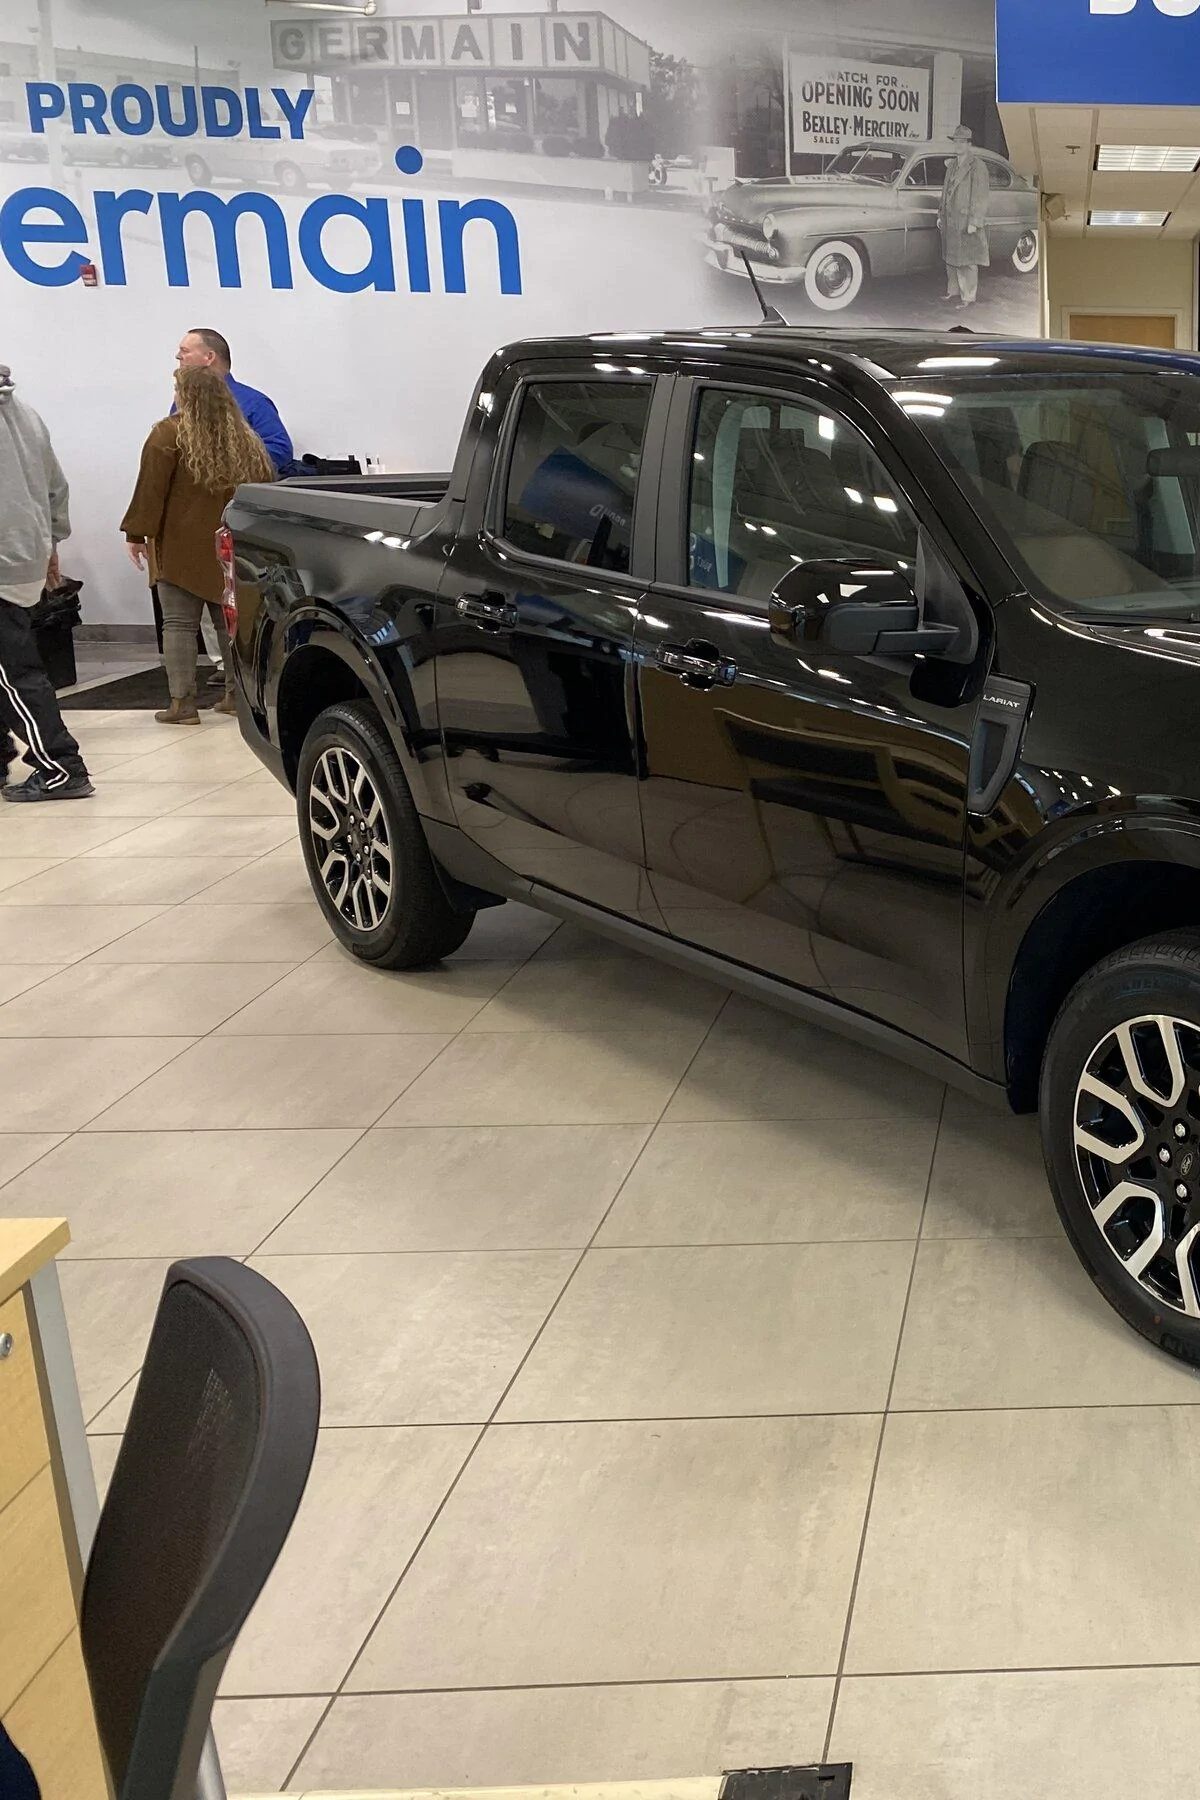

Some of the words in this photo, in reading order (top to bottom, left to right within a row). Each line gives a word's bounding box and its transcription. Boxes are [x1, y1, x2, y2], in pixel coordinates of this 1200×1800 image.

[279, 21, 592, 62] GERMAIN
[25, 81, 315, 140] PROUDLY
[801, 81, 873, 109] OPENING
[878, 88, 919, 112] SOON
[813, 135, 840, 145] SALES
[0, 145, 522, 295] ermain
[983, 694, 1020, 708] LARIAT
